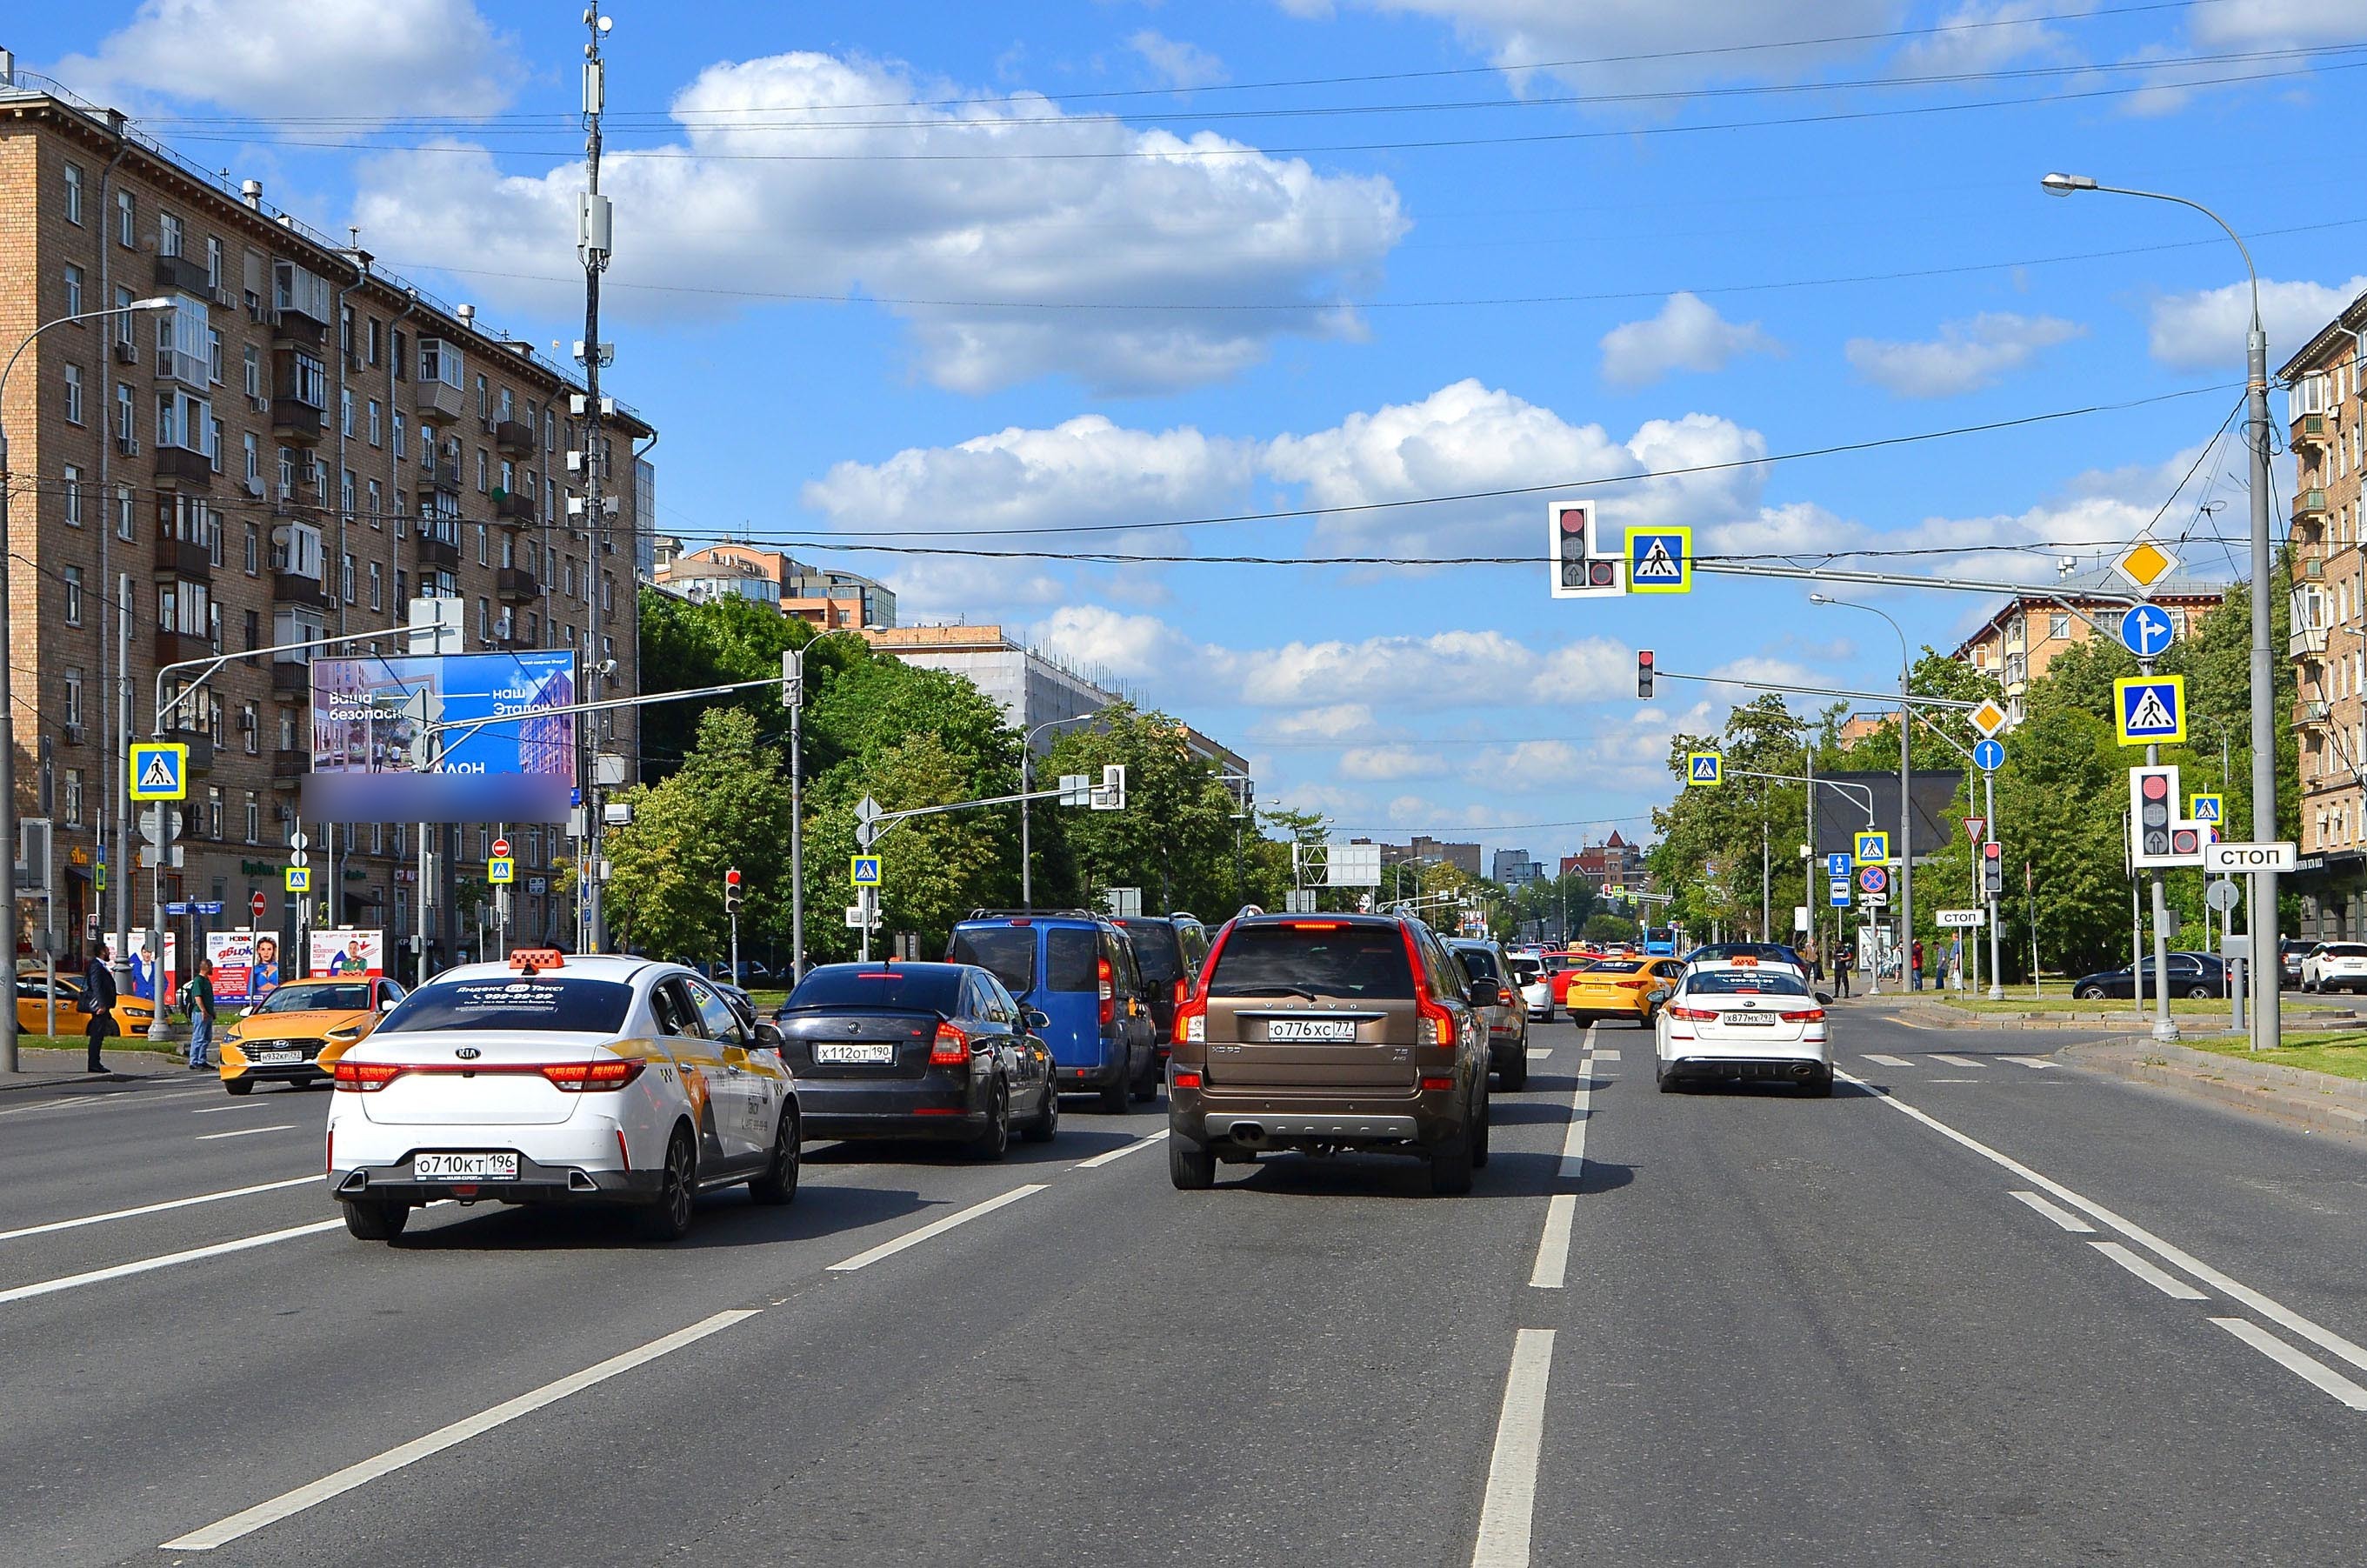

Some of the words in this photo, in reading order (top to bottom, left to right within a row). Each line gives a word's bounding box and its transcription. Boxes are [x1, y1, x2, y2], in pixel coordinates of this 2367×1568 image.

[330, 691, 373, 705] Ваша
[492, 688, 526, 700] наш
[2220, 850, 2280, 865] СТОП
[1944, 913, 1977, 923] СТОП
[1336, 1021, 1350, 1032] 77
[458, 1047, 477, 1058] KIA
[871, 1046, 889, 1056] 190
[489, 1155, 513, 1168] 196
